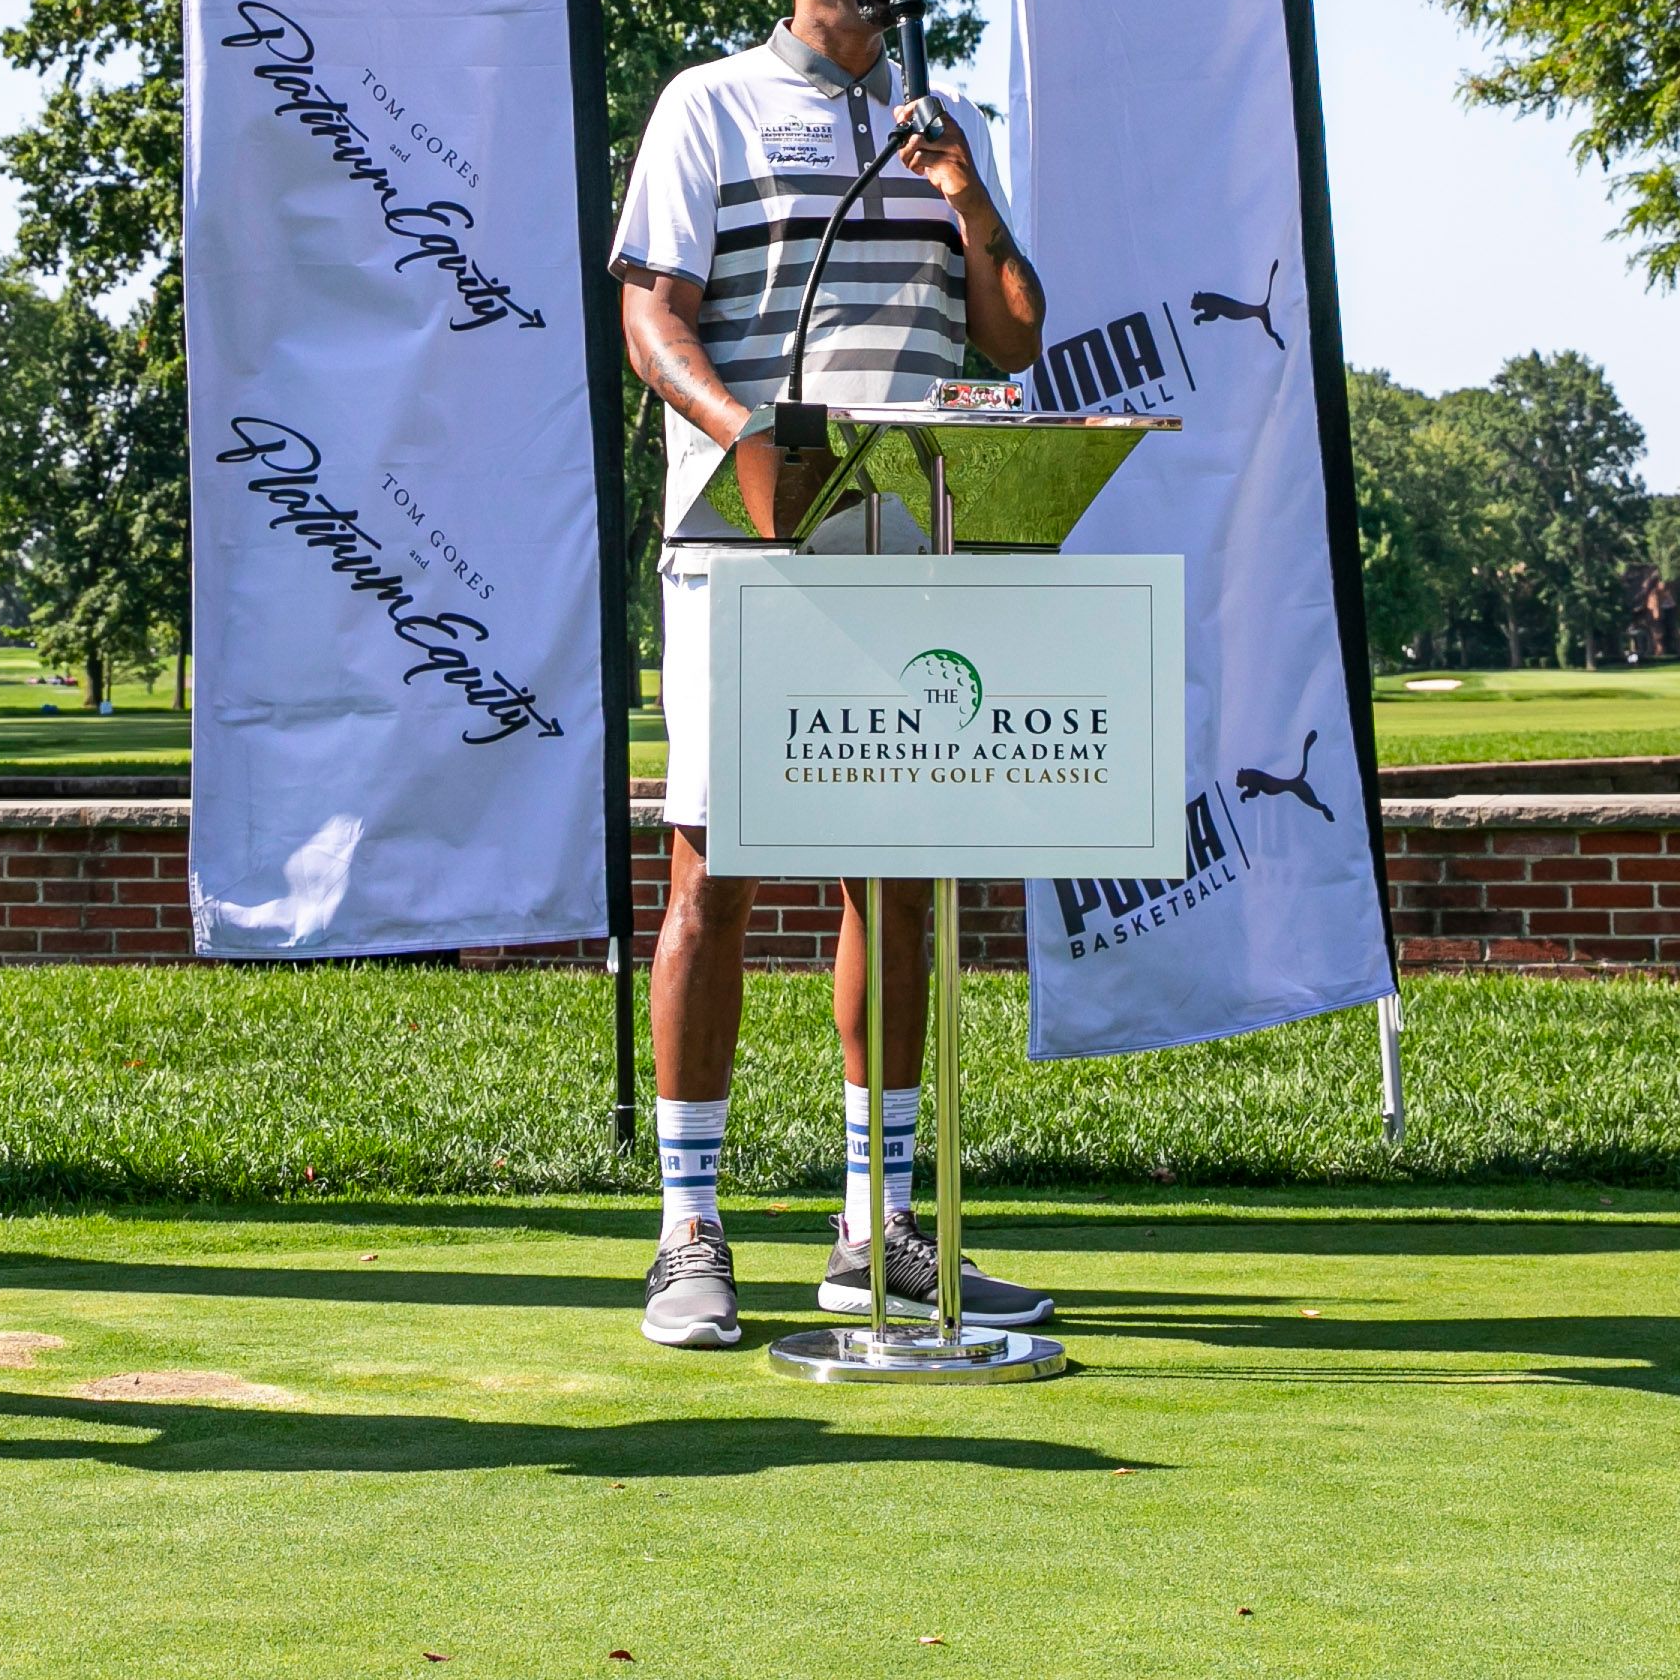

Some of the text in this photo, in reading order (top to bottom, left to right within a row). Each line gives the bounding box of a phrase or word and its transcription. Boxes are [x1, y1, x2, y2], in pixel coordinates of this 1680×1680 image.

[361, 67, 482, 190] TOM GORES
[390, 143, 410, 164] and
[382, 473, 495, 601] TOM GORES
[408, 548, 430, 570] and
[924, 688, 959, 705] THE
[786, 708, 1109, 741] JALEN ROSE
[785, 743, 1108, 761] LEADERSHIP ACADEMY
[785, 767, 1109, 785] CELEBRITY GOLF CLASSIC
[1069, 862, 1236, 961] BASKETBALL
